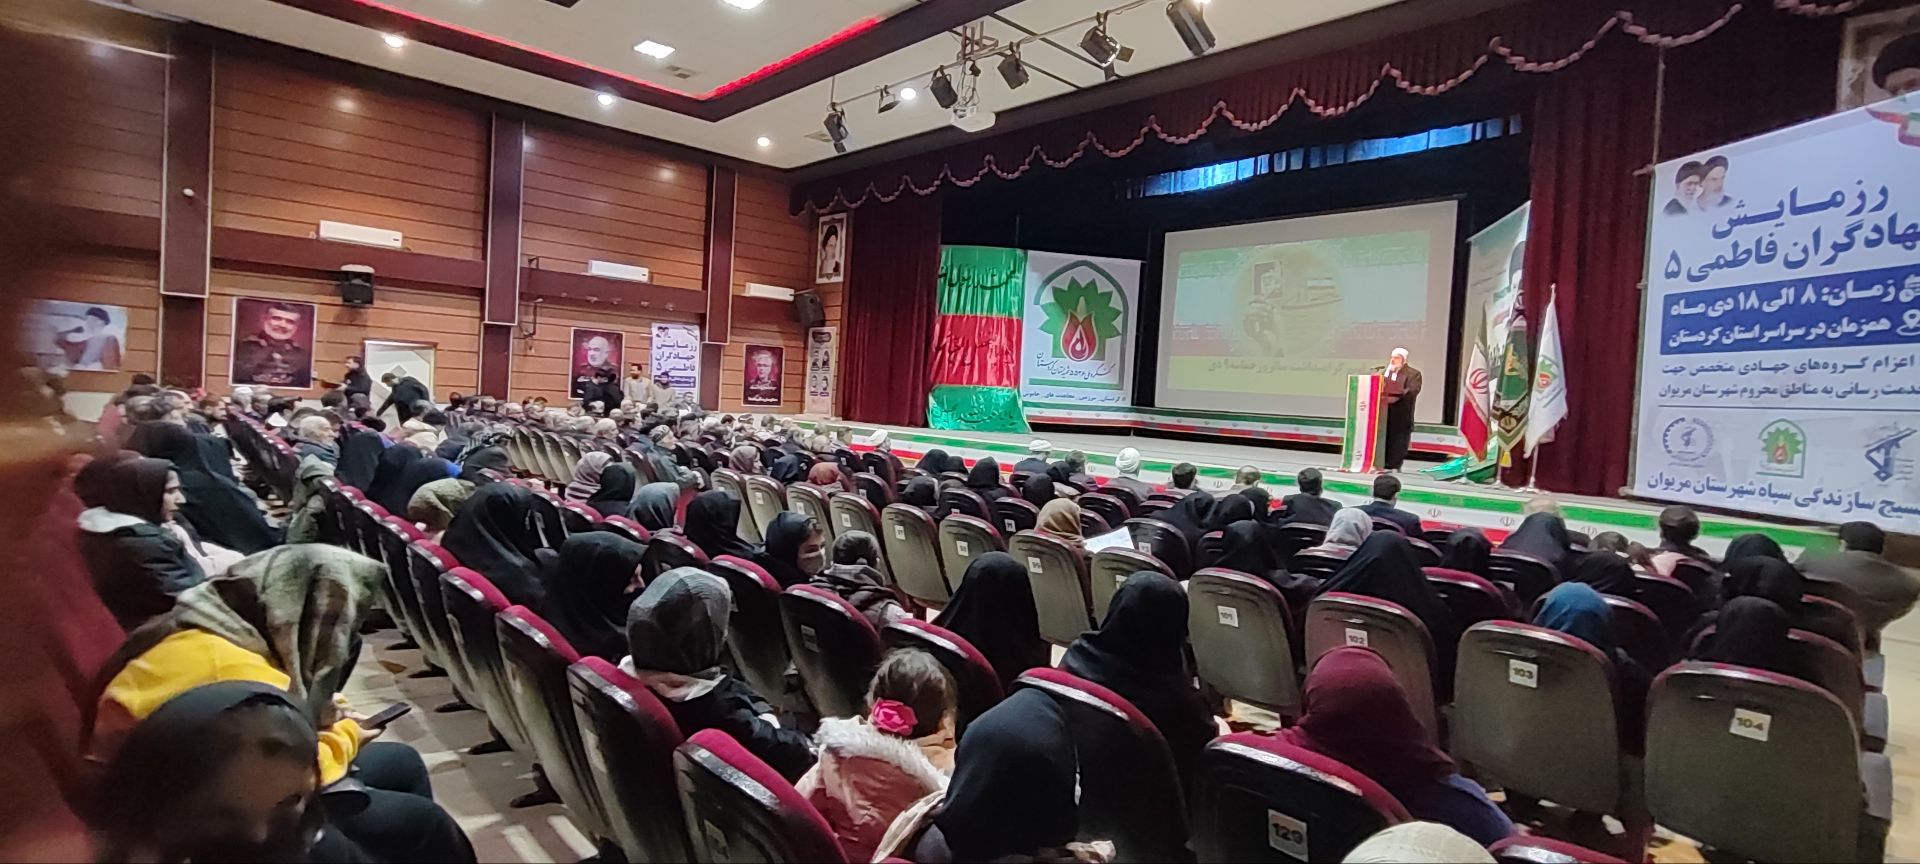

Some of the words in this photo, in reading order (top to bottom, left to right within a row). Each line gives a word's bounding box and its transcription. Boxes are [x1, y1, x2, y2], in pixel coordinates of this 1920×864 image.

[1712, 180, 1889, 239] رزمایش
[1783, 212, 1920, 269] هادگران
[1664, 249, 1682, 281] ۵
[1686, 232, 1777, 282] فاطمی
[1738, 290, 1760, 311] ۱۸
[1762, 286, 1795, 312] الی
[1800, 283, 1817, 305] ۸
[1821, 279, 1896, 306] زمان:
[1670, 298, 1706, 316] ماه
[1707, 297, 1734, 317] دی
[1668, 326, 1723, 347] کردستان
[1721, 323, 1760, 344] استان
[1758, 322, 1806, 343] سراسر
[1805, 322, 1826, 340] در
[1826, 316, 1892, 338] همزمان
[1662, 364, 1686, 376] جهت
[1689, 361, 1735, 376] متخصص
[1738, 360, 1790, 376] جهادی
[1872, 354, 1915, 373] اعزام
[1658, 383, 1692, 398] مریوان
[1692, 383, 1738, 399] شهرستان
[1740, 386, 1778, 399] محروم
[1780, 382, 1819, 398] مناطق
[1821, 385, 1834, 398] به
[1881, 384, 1920, 395] دمت
[1647, 471, 1692, 492] مریوان
[1692, 476, 1757, 499] شهرستان
[1758, 482, 1792, 505] سپاه
[1794, 487, 1876, 513] سازندگی
[1878, 499, 1920, 519] سیج
[1348, 634, 1366, 645] 102
[1512, 666, 1534, 680] 103
[1735, 716, 1764, 732] 104
[1271, 822, 1304, 845] 129
